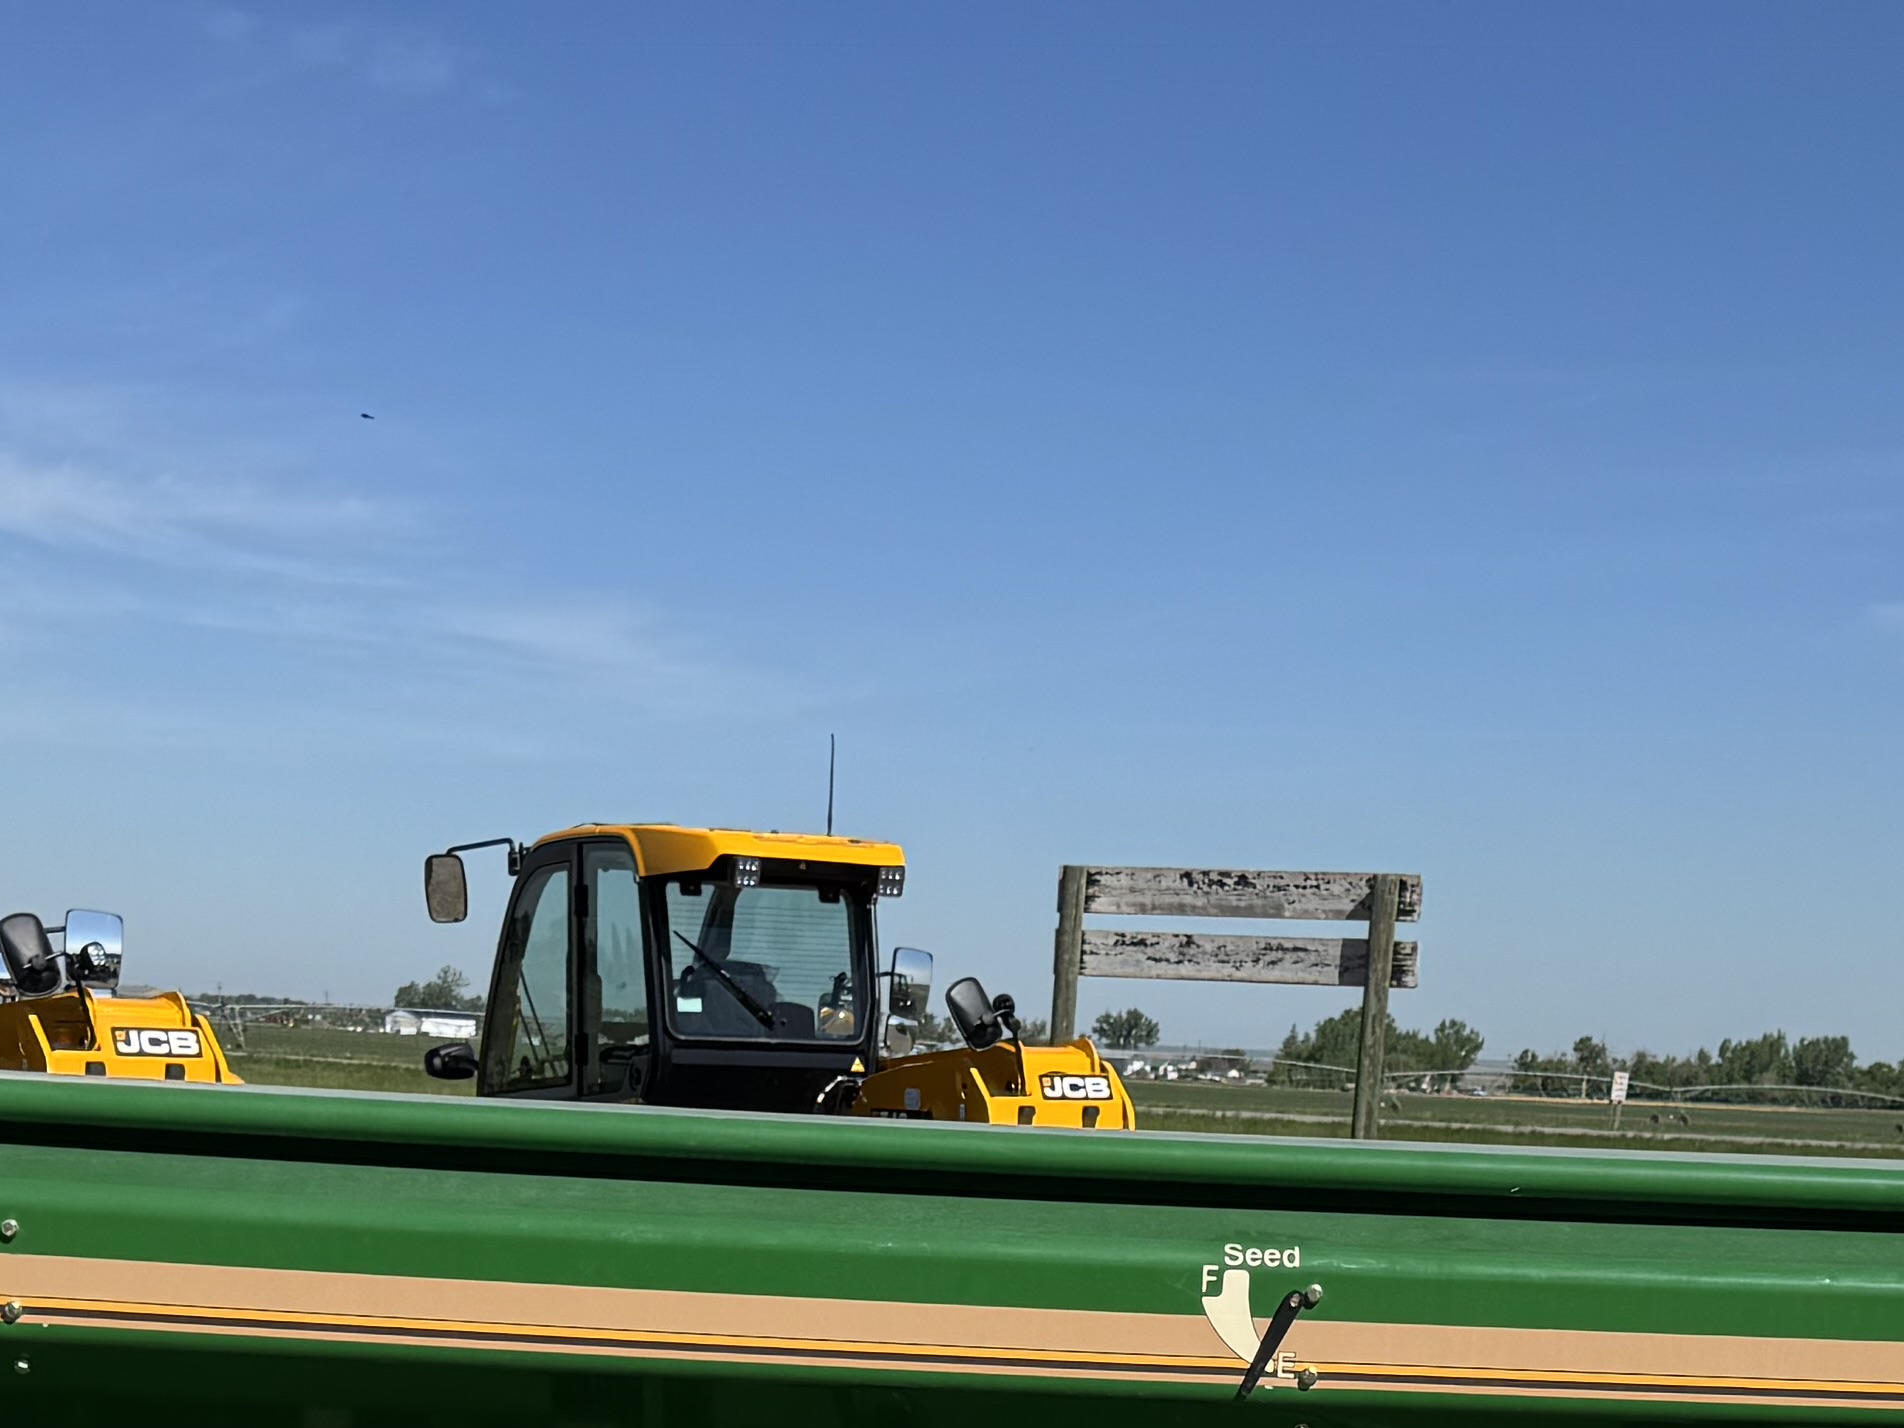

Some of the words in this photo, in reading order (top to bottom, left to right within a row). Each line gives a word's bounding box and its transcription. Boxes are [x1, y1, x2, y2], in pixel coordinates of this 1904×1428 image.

[116, 1029, 199, 1055] JCB
[1043, 1076, 1110, 1099] JCB
[1224, 1243, 1301, 1268] Seed
[1201, 1264, 1219, 1293] F
[1277, 1351, 1297, 1379] E
